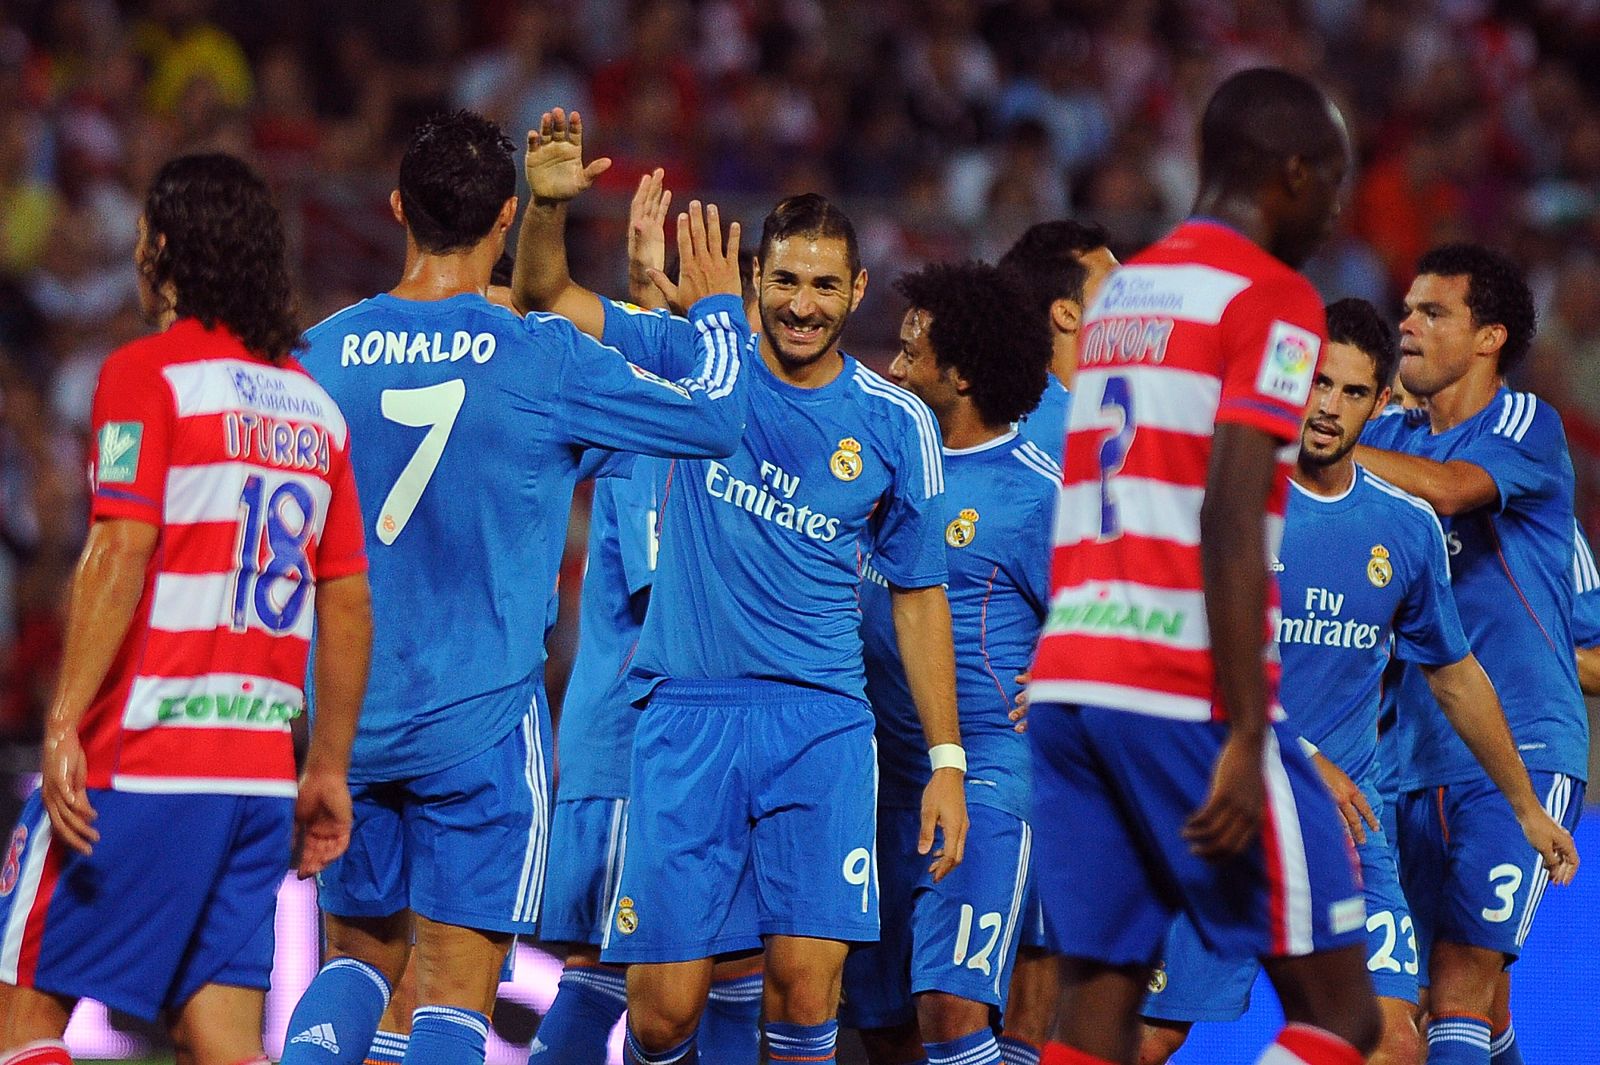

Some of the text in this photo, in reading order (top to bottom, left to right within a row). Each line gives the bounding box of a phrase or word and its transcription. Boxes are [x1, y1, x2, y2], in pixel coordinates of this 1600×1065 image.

[341, 330, 497, 367] RONALDO
[1084, 317, 1174, 365] NYOM
[226, 412, 330, 475] ITURRA
[375, 378, 466, 546] 7
[705, 460, 841, 542] Emirates
[760, 459, 801, 499] Fly
[231, 473, 317, 636] 18
[1273, 611, 1380, 649] mirates
[1305, 587, 1344, 617] Fly
[843, 847, 870, 913] 9
[1482, 863, 1523, 922] 3
[953, 903, 1002, 976] 12
[1366, 910, 1419, 975] 23
[290, 1035, 341, 1055] adidas
